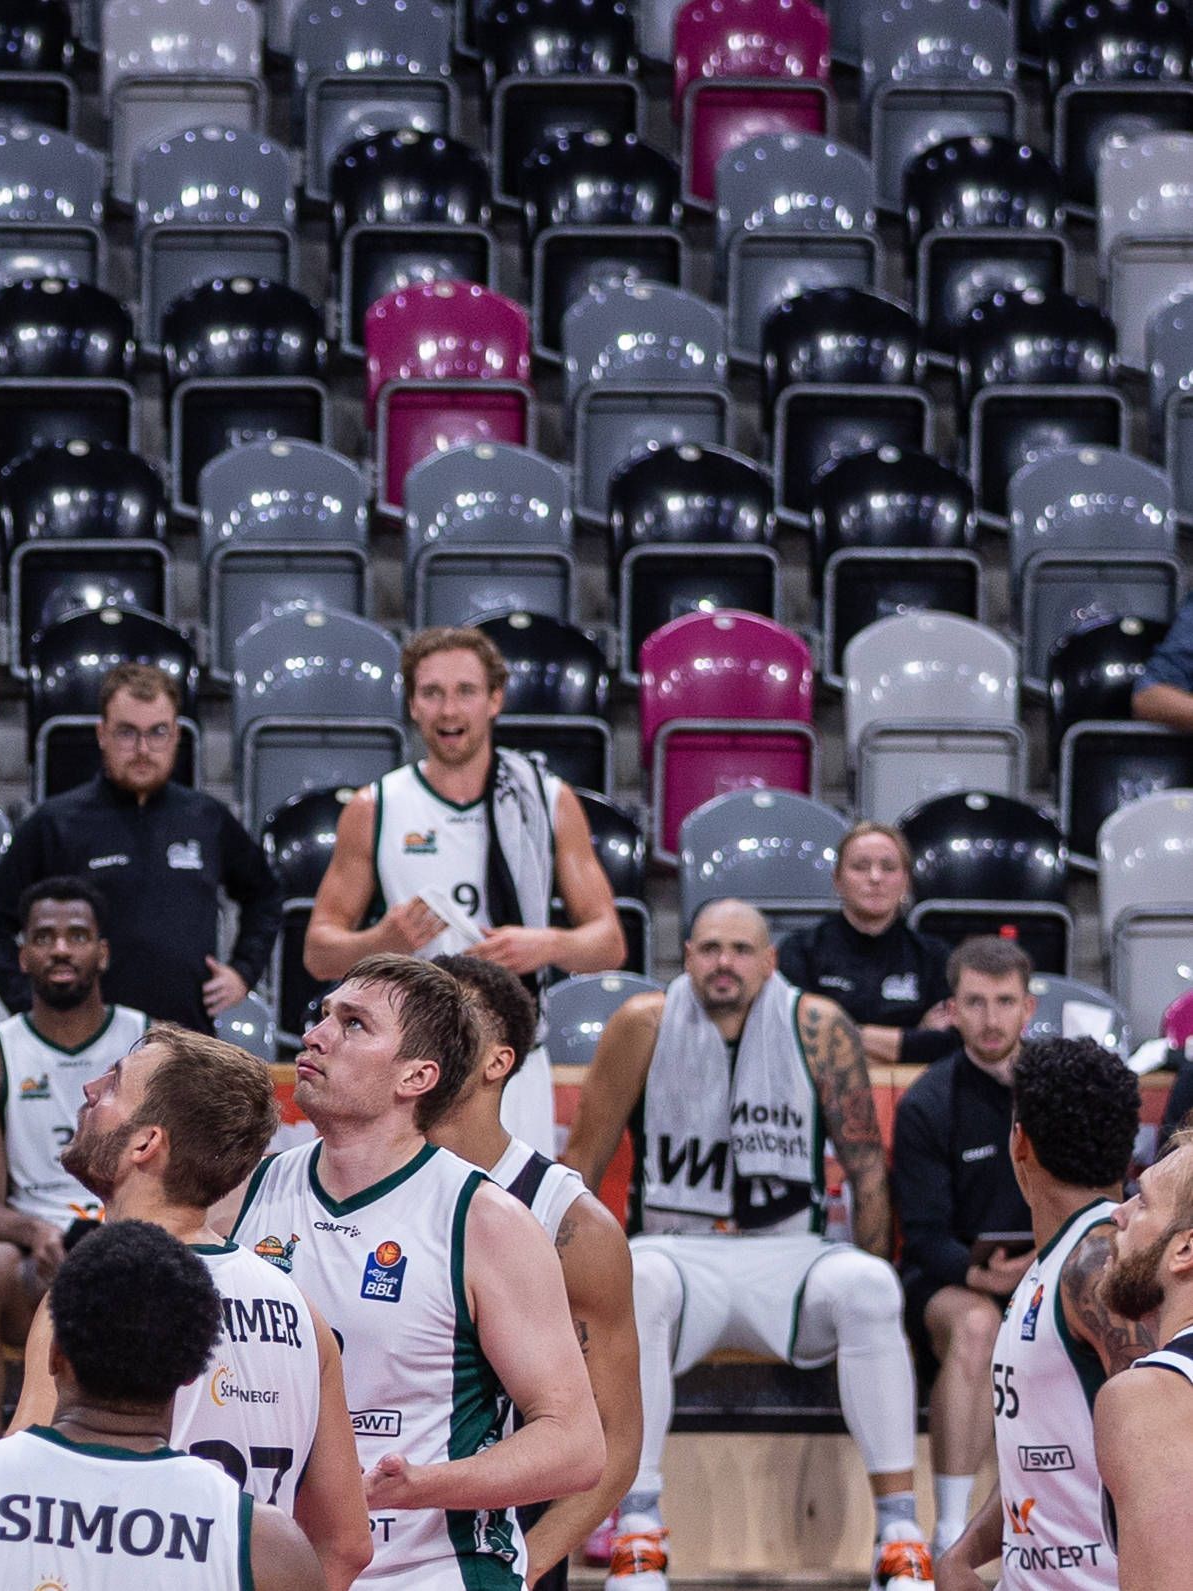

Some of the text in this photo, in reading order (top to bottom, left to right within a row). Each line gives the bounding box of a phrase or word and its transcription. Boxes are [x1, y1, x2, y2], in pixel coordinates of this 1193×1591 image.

[453, 882, 480, 918] 9
[314, 1221, 352, 1235] CRAFT
[364, 1281, 396, 1297] BBL
[352, 1415, 394, 1430] SWT
[1030, 1451, 1065, 1466] SWT
